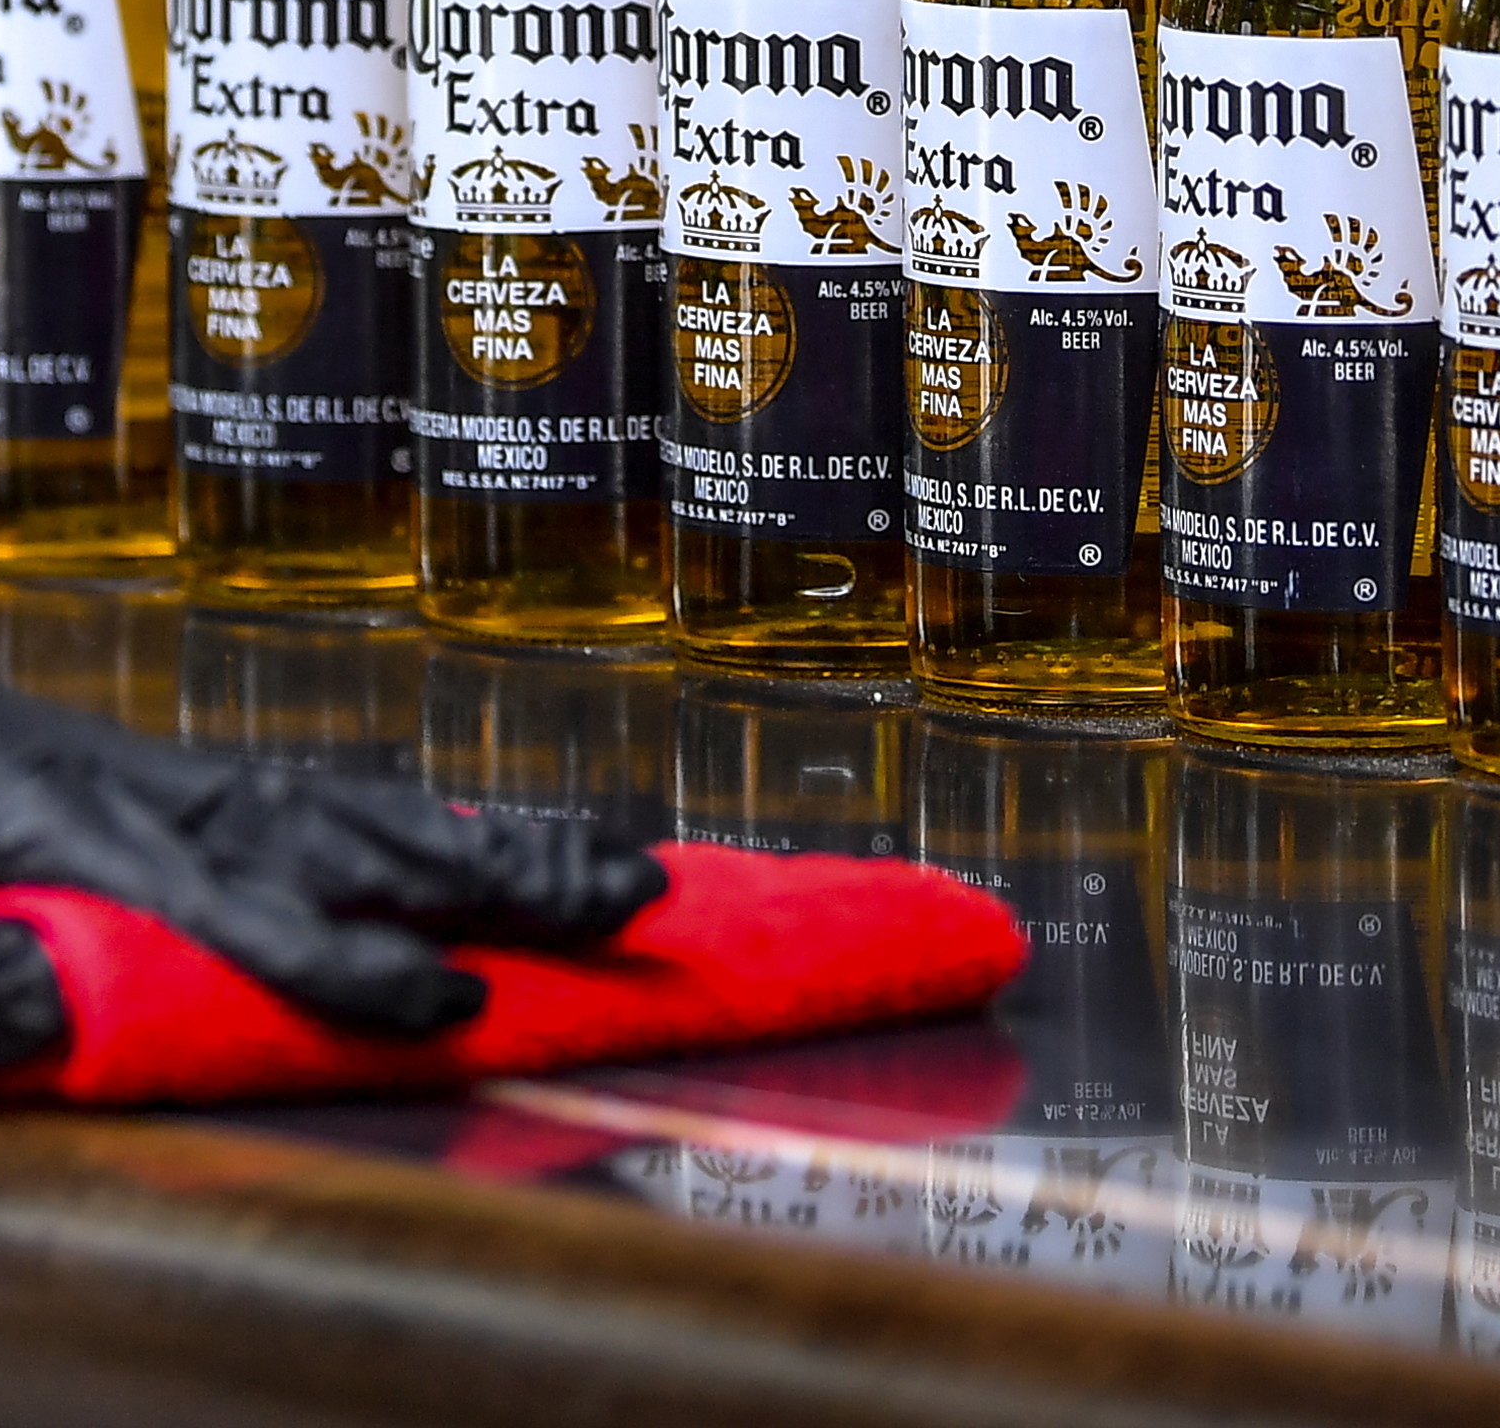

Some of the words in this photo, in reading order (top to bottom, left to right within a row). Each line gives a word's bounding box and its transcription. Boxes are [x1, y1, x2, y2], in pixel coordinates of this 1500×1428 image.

[190, 55, 330, 120] Extra
[902, 45, 1083, 122] orona
[444, 70, 601, 136] Extra
[1161, 71, 1355, 149] orona
[672, 93, 806, 169] Extra
[904, 117, 1017, 195] Extra
[1164, 142, 1287, 223] Extra
[215, 234, 250, 259] LA
[187, 255, 293, 289] CERVEZA
[482, 254, 519, 277] LA
[208, 287, 261, 315] MAS
[447, 279, 568, 306] CERVEZA
[702, 280, 730, 305] LA
[818, 280, 847, 298] Alc.
[850, 280, 890, 298] 4.5%
[473, 308, 532, 333] MAS
[677, 304, 774, 336] CERVEZA
[850, 301, 889, 320] BEER
[927, 307, 952, 332] LA
[1030, 309, 1058, 327] Alc.
[1061, 309, 1103, 327] 4.5%
[1103, 309, 1134, 327] Vol.
[206, 312, 262, 341] FINA
[1062, 331, 1101, 350] BEER
[472, 336, 534, 360] FINA
[695, 335, 741, 362] MAS
[908, 330, 992, 364] CERVEZA
[1190, 342, 1217, 368] LA
[1301, 339, 1331, 357] Alc.
[1334, 339, 1377, 358] 4.5%
[1378, 339, 1409, 358] Vol.
[694, 362, 742, 391] FINA
[921, 362, 962, 390] MAS
[1168, 367, 1258, 401] CERVEZA
[1334, 361, 1375, 382] BEER
[920, 390, 963, 419] FINA
[1183, 399, 1227, 427] MAS
[559, 417, 585, 443] DE
[1182, 429, 1228, 457] FINA
[477, 444, 548, 471] MEXICO
[741, 452, 759, 478] S.
[761, 454, 785, 479] DE
[789, 455, 826, 480] R.L.
[828, 456, 854, 480] DE
[858, 456, 892, 480] C.V.
[694, 475, 748, 504] MEXICO
[957, 482, 972, 508] S.
[975, 484, 997, 510] DE
[1001, 485, 1036, 511] R.L.
[1039, 487, 1066, 512] DE
[1069, 488, 1105, 513] C.V.
[736, 510, 766, 525] 7417
[918, 504, 963, 535] MEXICO
[1225, 516, 1241, 542] S.
[1245, 518, 1267, 545] DE
[1272, 520, 1308, 546] R.L.
[1312, 521, 1338, 547] DE
[1343, 522, 1380, 548] C.V.
[952, 541, 978, 556] 7417
[1181, 539, 1232, 570] MEXICO
[1220, 576, 1247, 592] 7417
